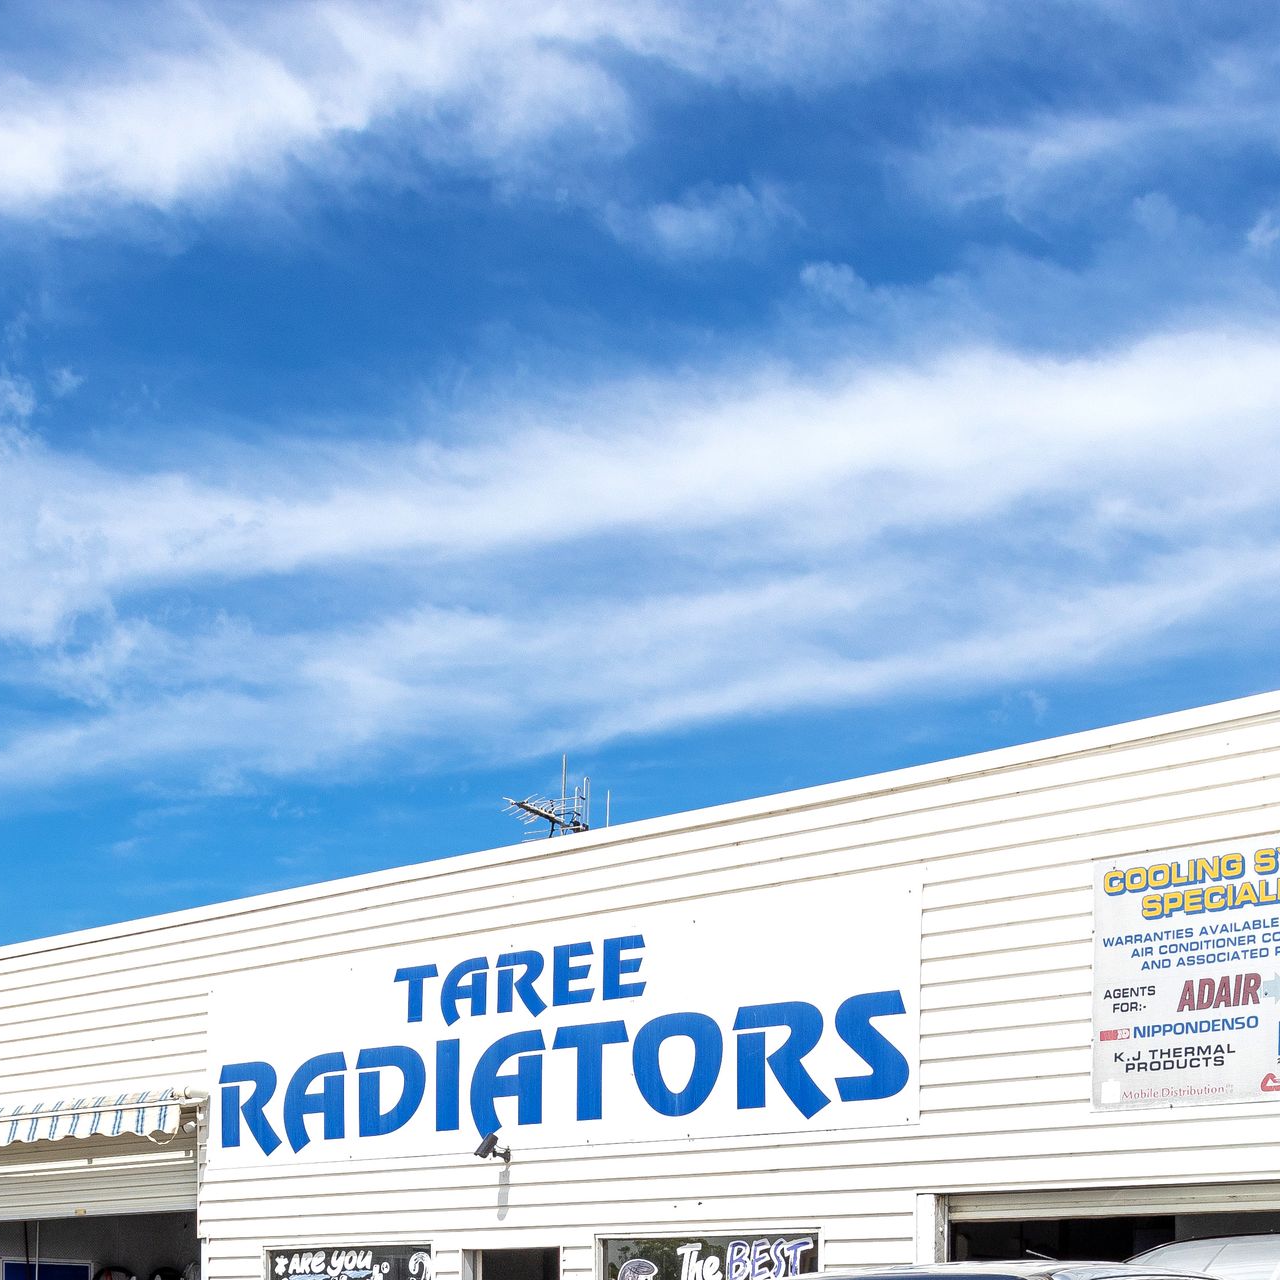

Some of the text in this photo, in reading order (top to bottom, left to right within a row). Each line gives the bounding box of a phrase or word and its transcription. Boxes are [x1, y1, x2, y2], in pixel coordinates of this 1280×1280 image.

[1104, 853, 1245, 896] COOLING
[1103, 928, 1193, 947] WARRANTIES
[1199, 917, 1279, 936] AVAILABLE
[1131, 947, 1153, 958] AIR
[1158, 935, 1256, 955] CONDITIONER
[1141, 959, 1171, 971] AND
[1176, 948, 1269, 967] ASSOCIATED
[394, 934, 647, 1026] TAREE
[1104, 985, 1156, 999] AGENTS
[1177, 973, 1262, 1012] ADAIR
[1133, 1015, 1259, 1038] NIPPONDENSO
[1114, 1044, 1236, 1062] K.J THERMAL
[1125, 1056, 1225, 1073] PRODUCTS
[219, 990, 910, 1156] RADIATORS
[1121, 1087, 1159, 1100] Mobile
[1161, 1084, 1225, 1098] Distribution
